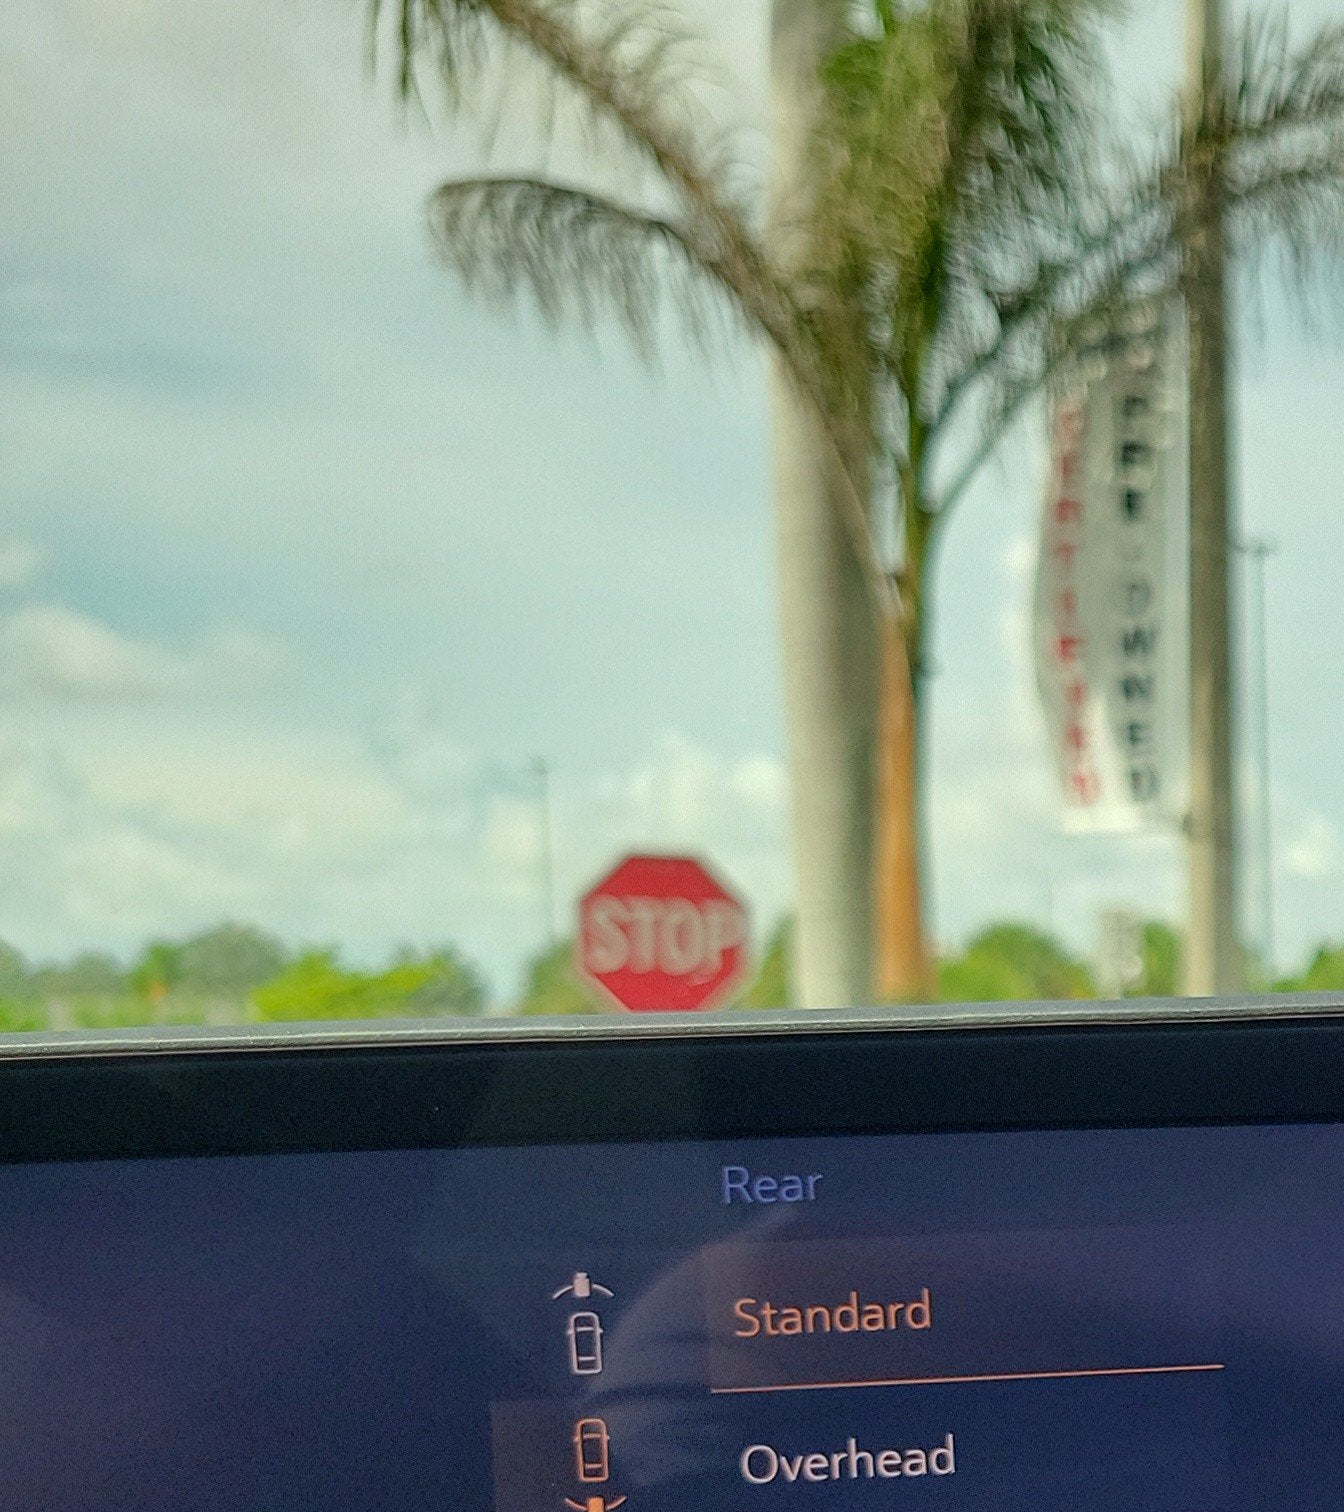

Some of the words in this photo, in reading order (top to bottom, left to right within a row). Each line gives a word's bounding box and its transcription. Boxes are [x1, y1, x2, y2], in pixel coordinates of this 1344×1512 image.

[590, 895, 746, 976] STOP
[722, 1164, 823, 1204] Rear
[733, 1287, 932, 1338] Standard
[740, 1433, 956, 1484] Overhead
